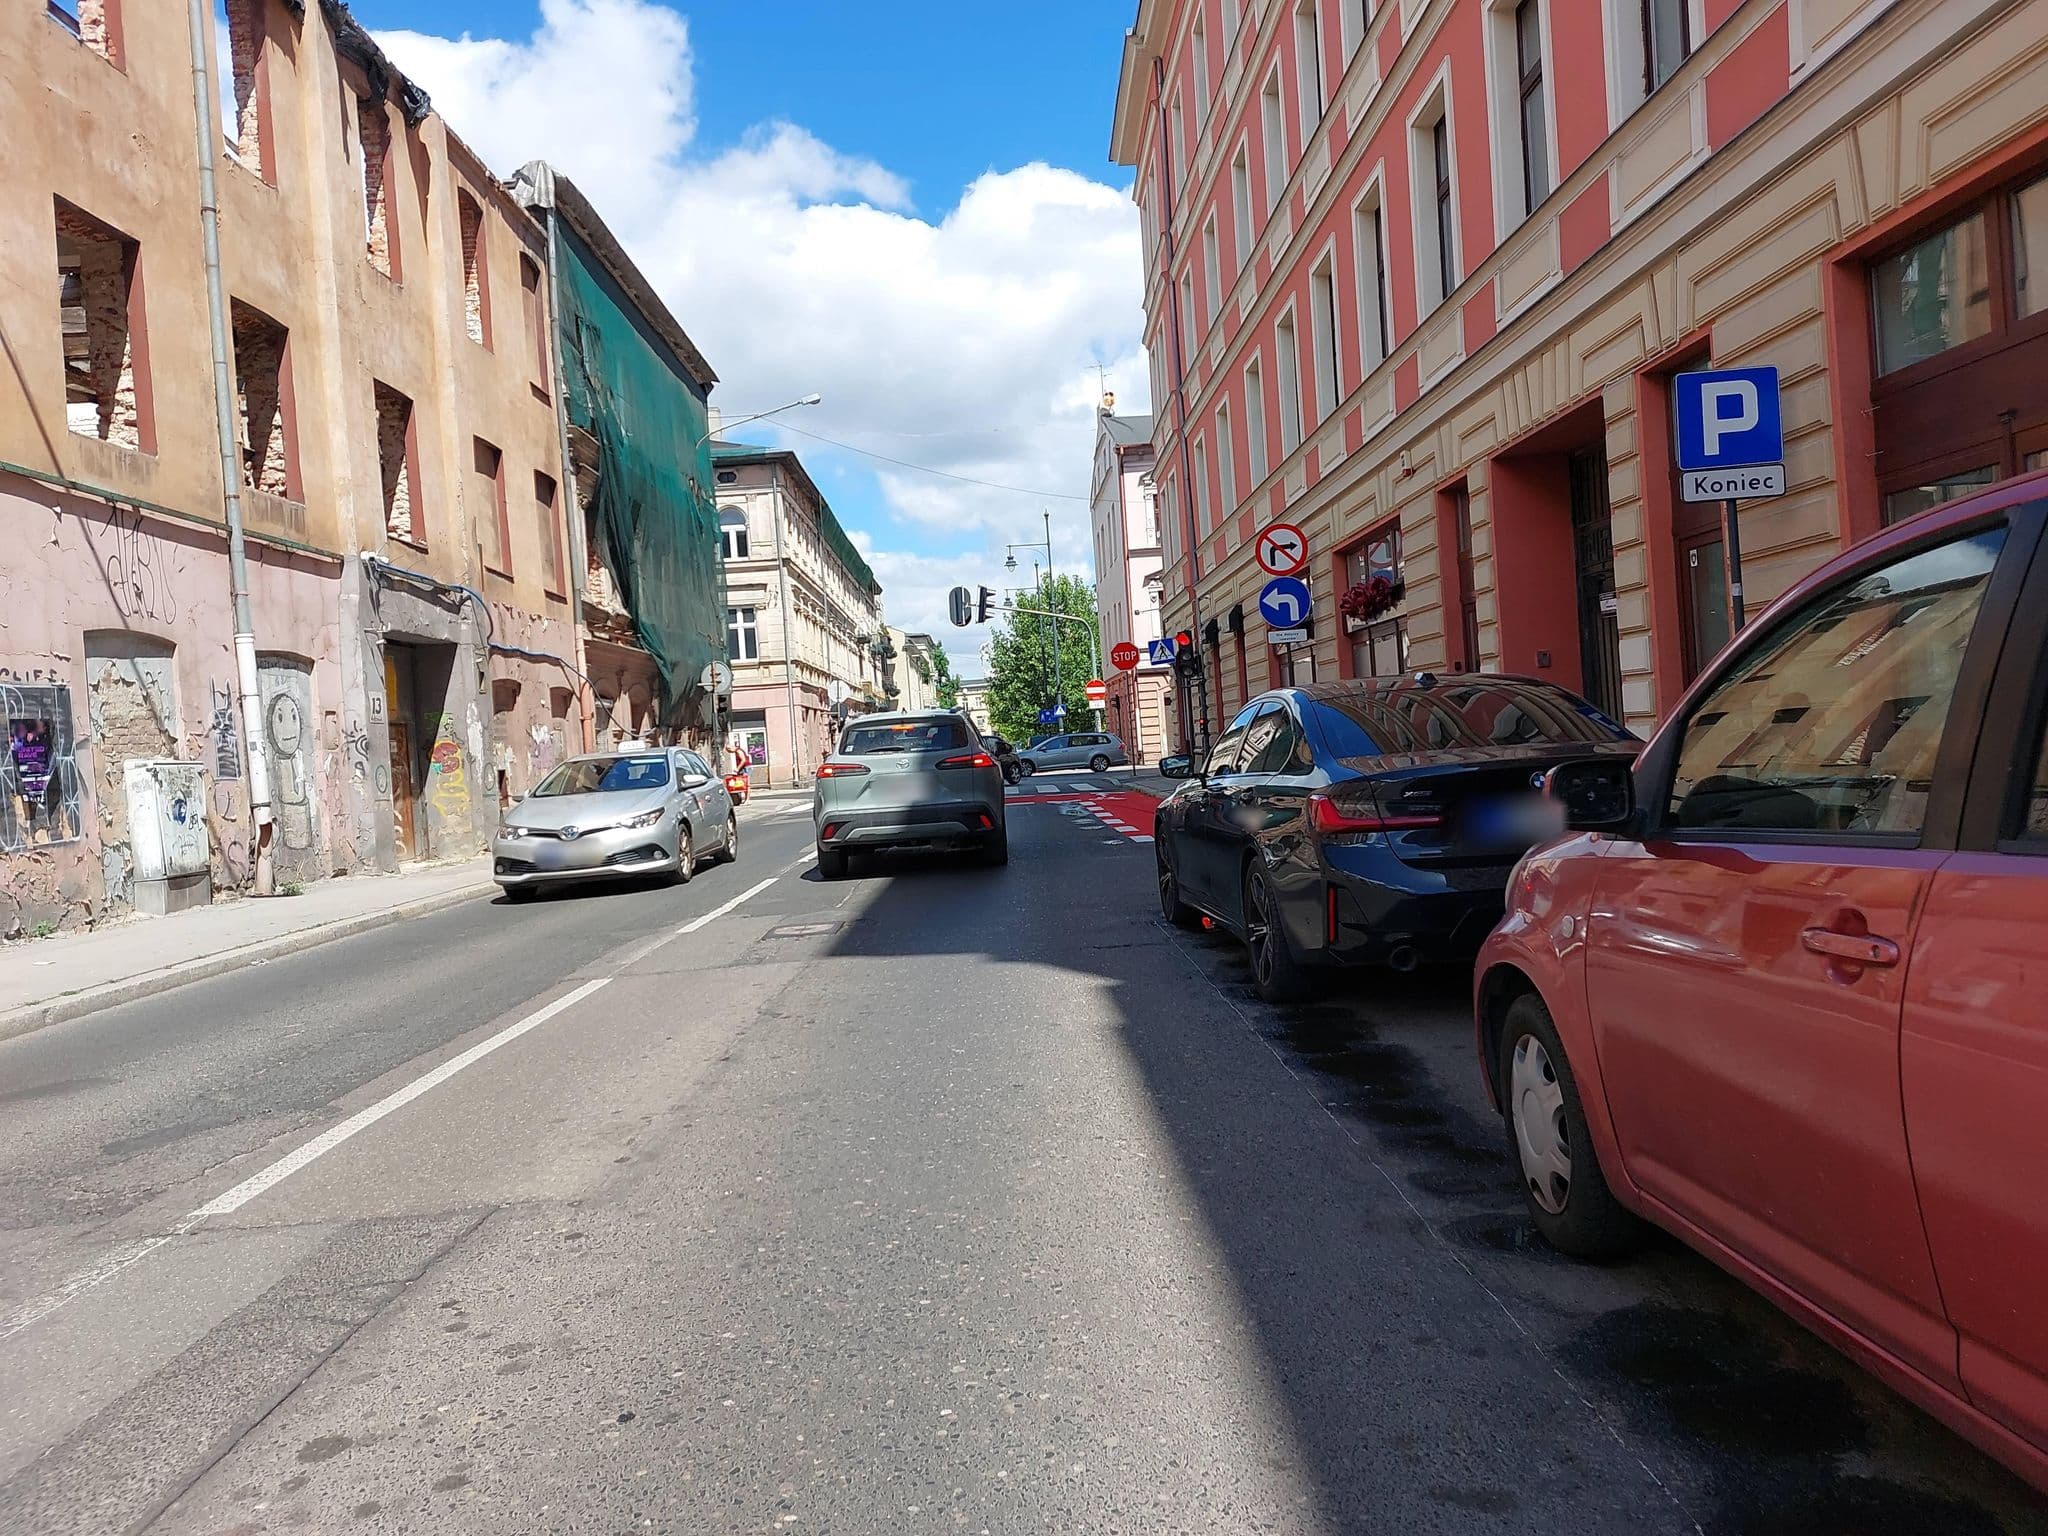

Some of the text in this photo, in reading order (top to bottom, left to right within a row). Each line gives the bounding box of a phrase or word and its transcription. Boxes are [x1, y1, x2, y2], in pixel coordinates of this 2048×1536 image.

[1701, 379, 1759, 456] P
[1694, 473, 1774, 494] Koniec
[1113, 651, 1137, 662] STOP
[371, 697, 382, 715] 13
